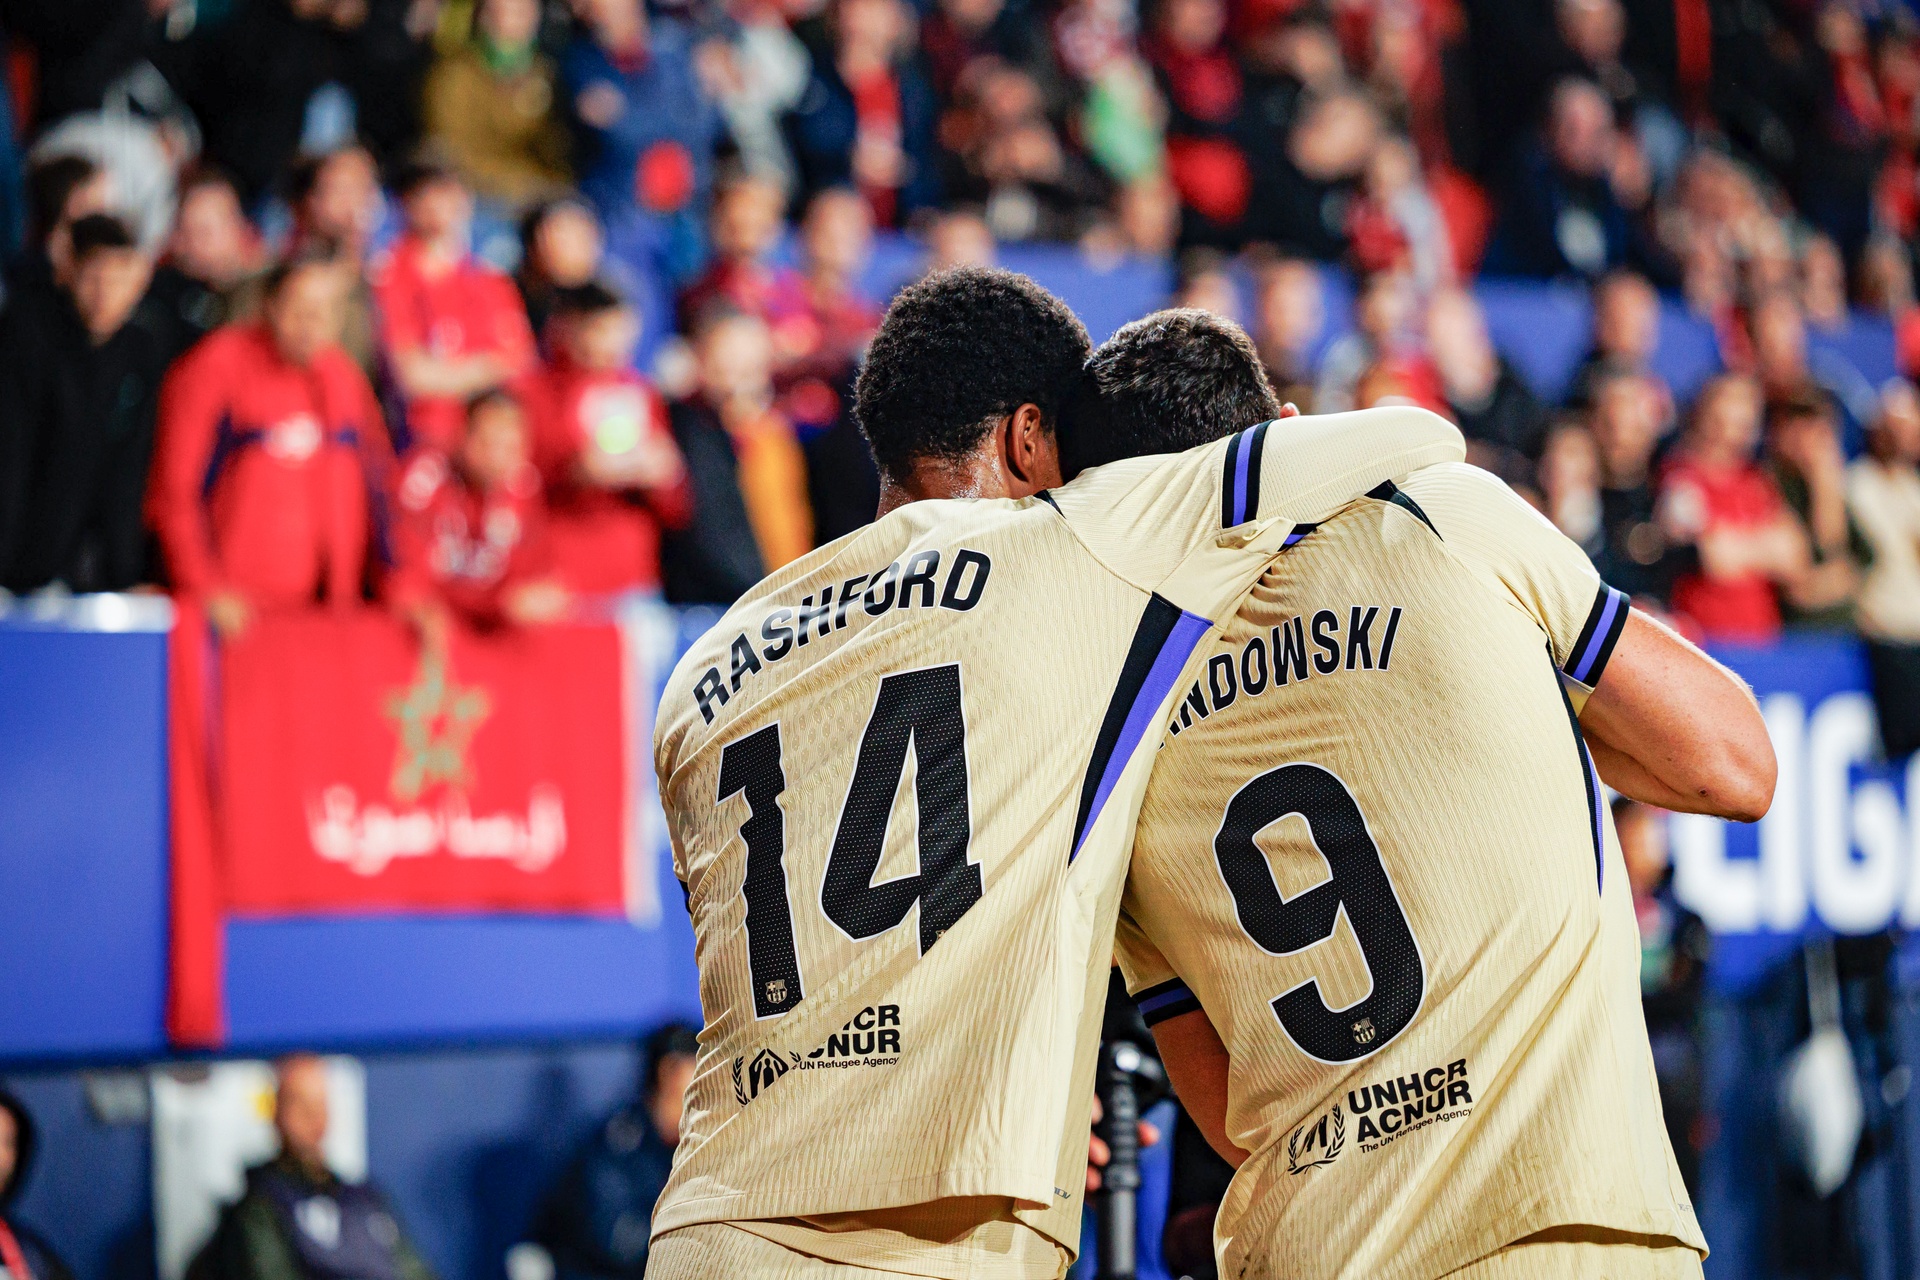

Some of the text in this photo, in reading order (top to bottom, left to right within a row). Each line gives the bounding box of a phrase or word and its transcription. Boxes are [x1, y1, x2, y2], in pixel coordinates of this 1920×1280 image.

[692, 548, 992, 726] RASHFORD
[1157, 605, 1402, 752] NDOWSKI
[715, 660, 986, 1022] 14
[1667, 692, 1920, 934] LIG
[1212, 760, 1427, 1066] 9
[799, 1061, 815, 1070] UN
[817, 1059, 861, 1069] Refugee
[862, 1057, 900, 1067] Agency
[1348, 1058, 1467, 1115] UNHCR
[1356, 1080, 1474, 1143] ACNUR
[1359, 1108, 1474, 1154] The UN Refugee Agency
